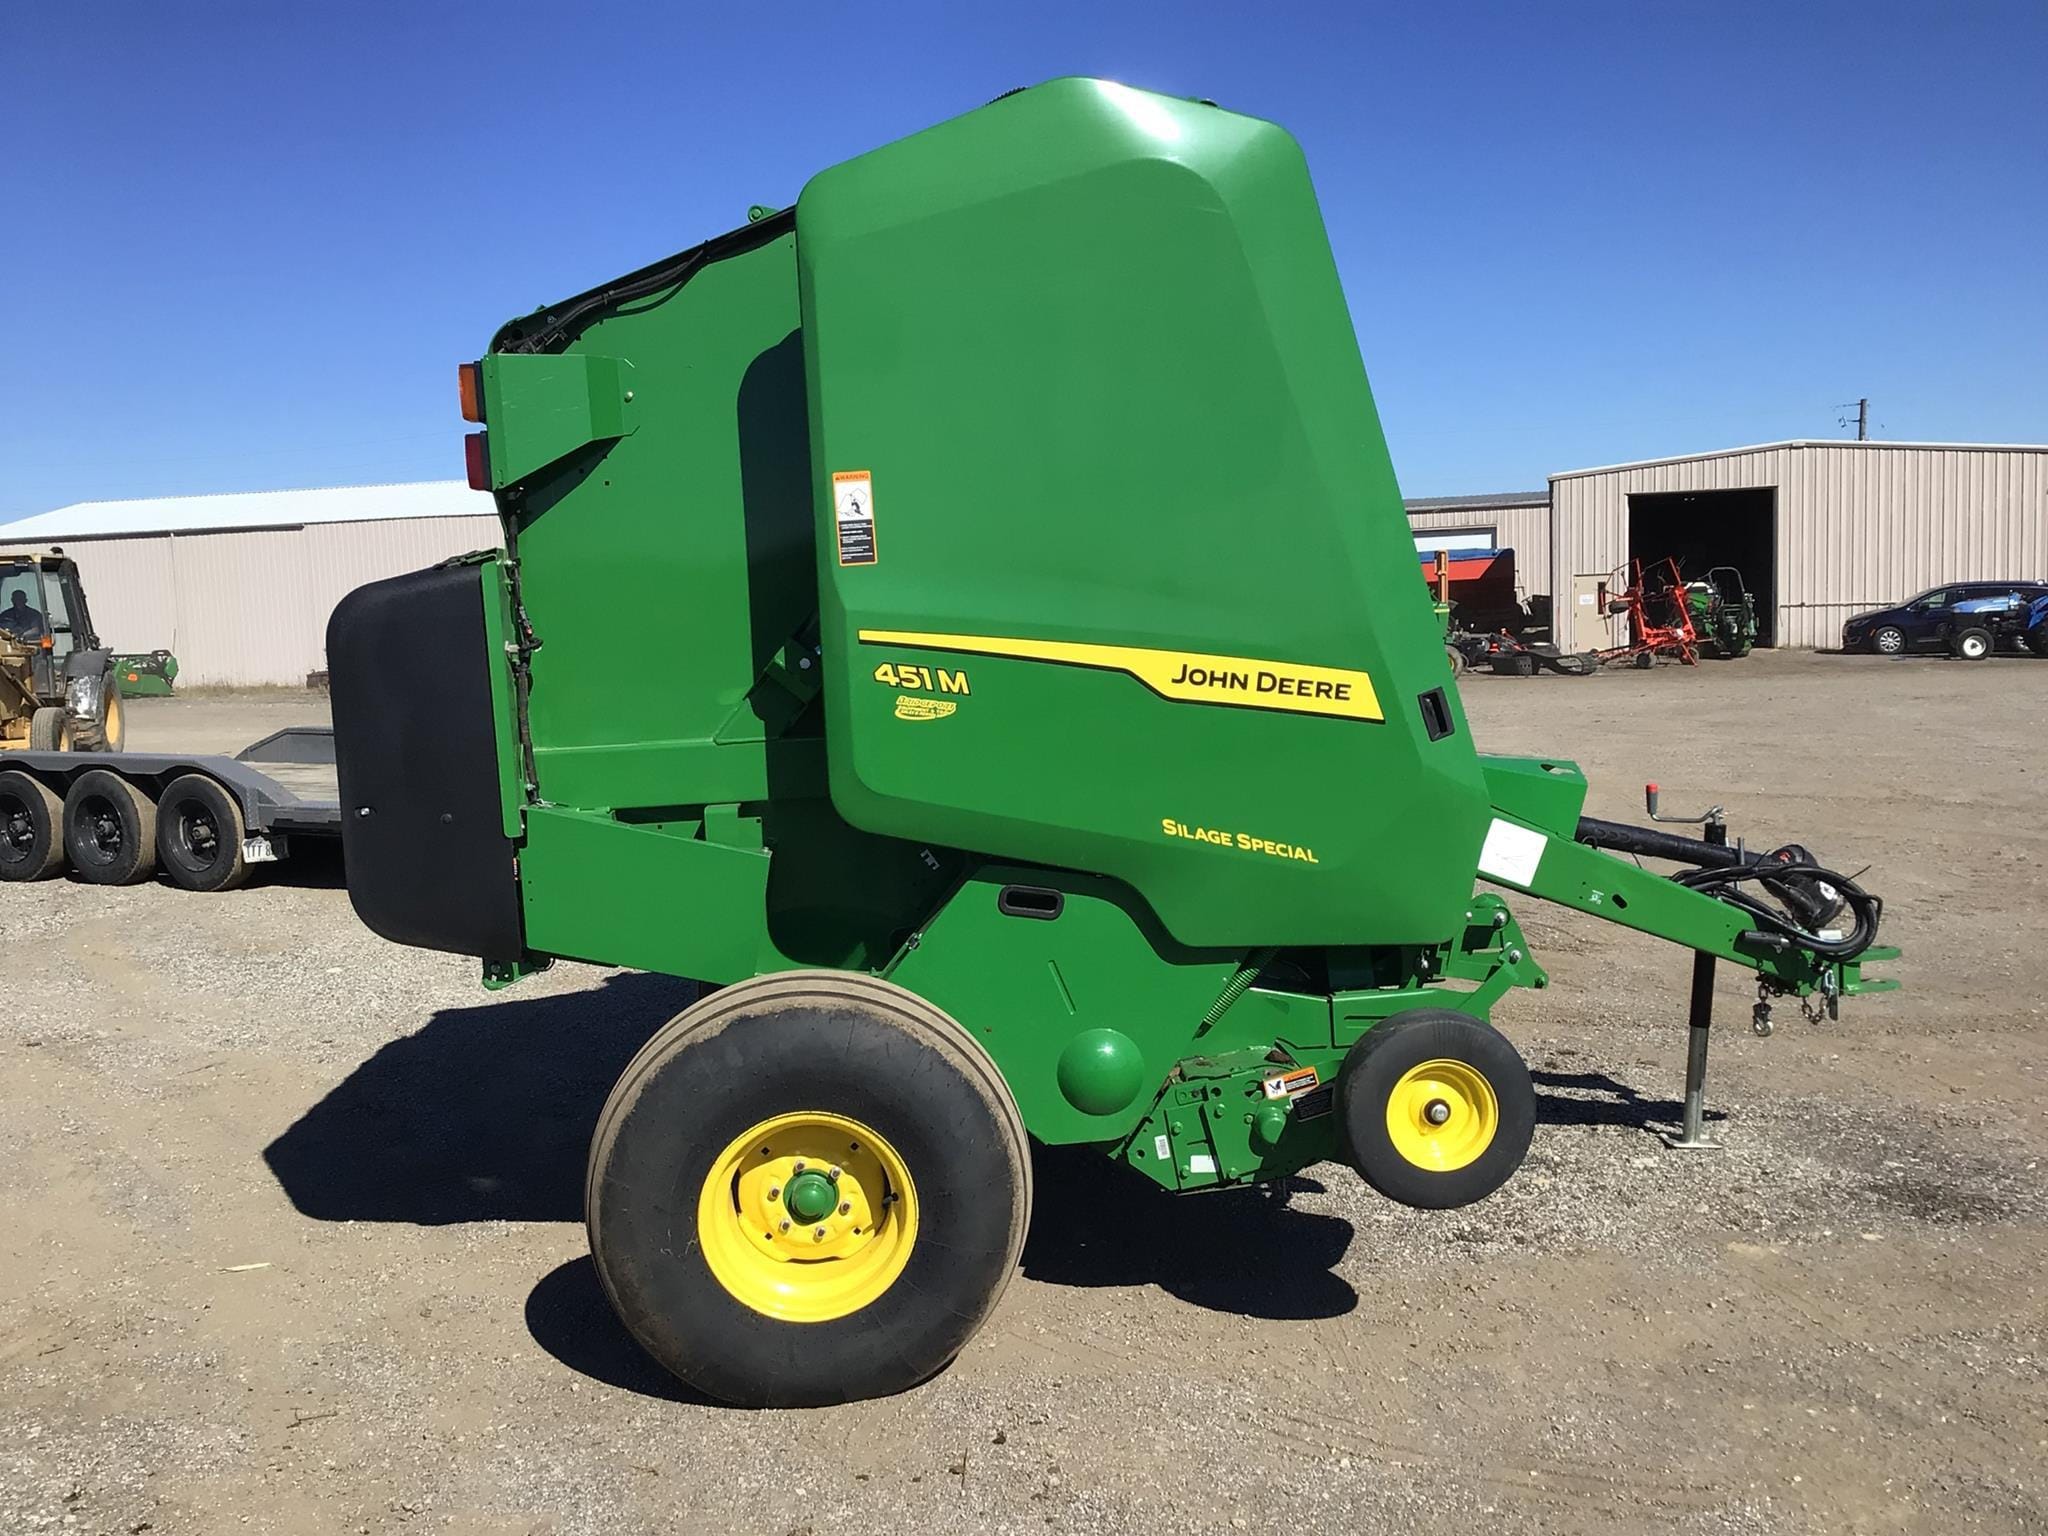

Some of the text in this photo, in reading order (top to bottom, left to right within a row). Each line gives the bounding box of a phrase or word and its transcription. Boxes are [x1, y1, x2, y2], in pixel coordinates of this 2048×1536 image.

[874, 662, 971, 695] 451 M
[1171, 663, 1352, 700] JOHN DEERE
[1162, 818, 1319, 863] SILAGE SPECIAL
